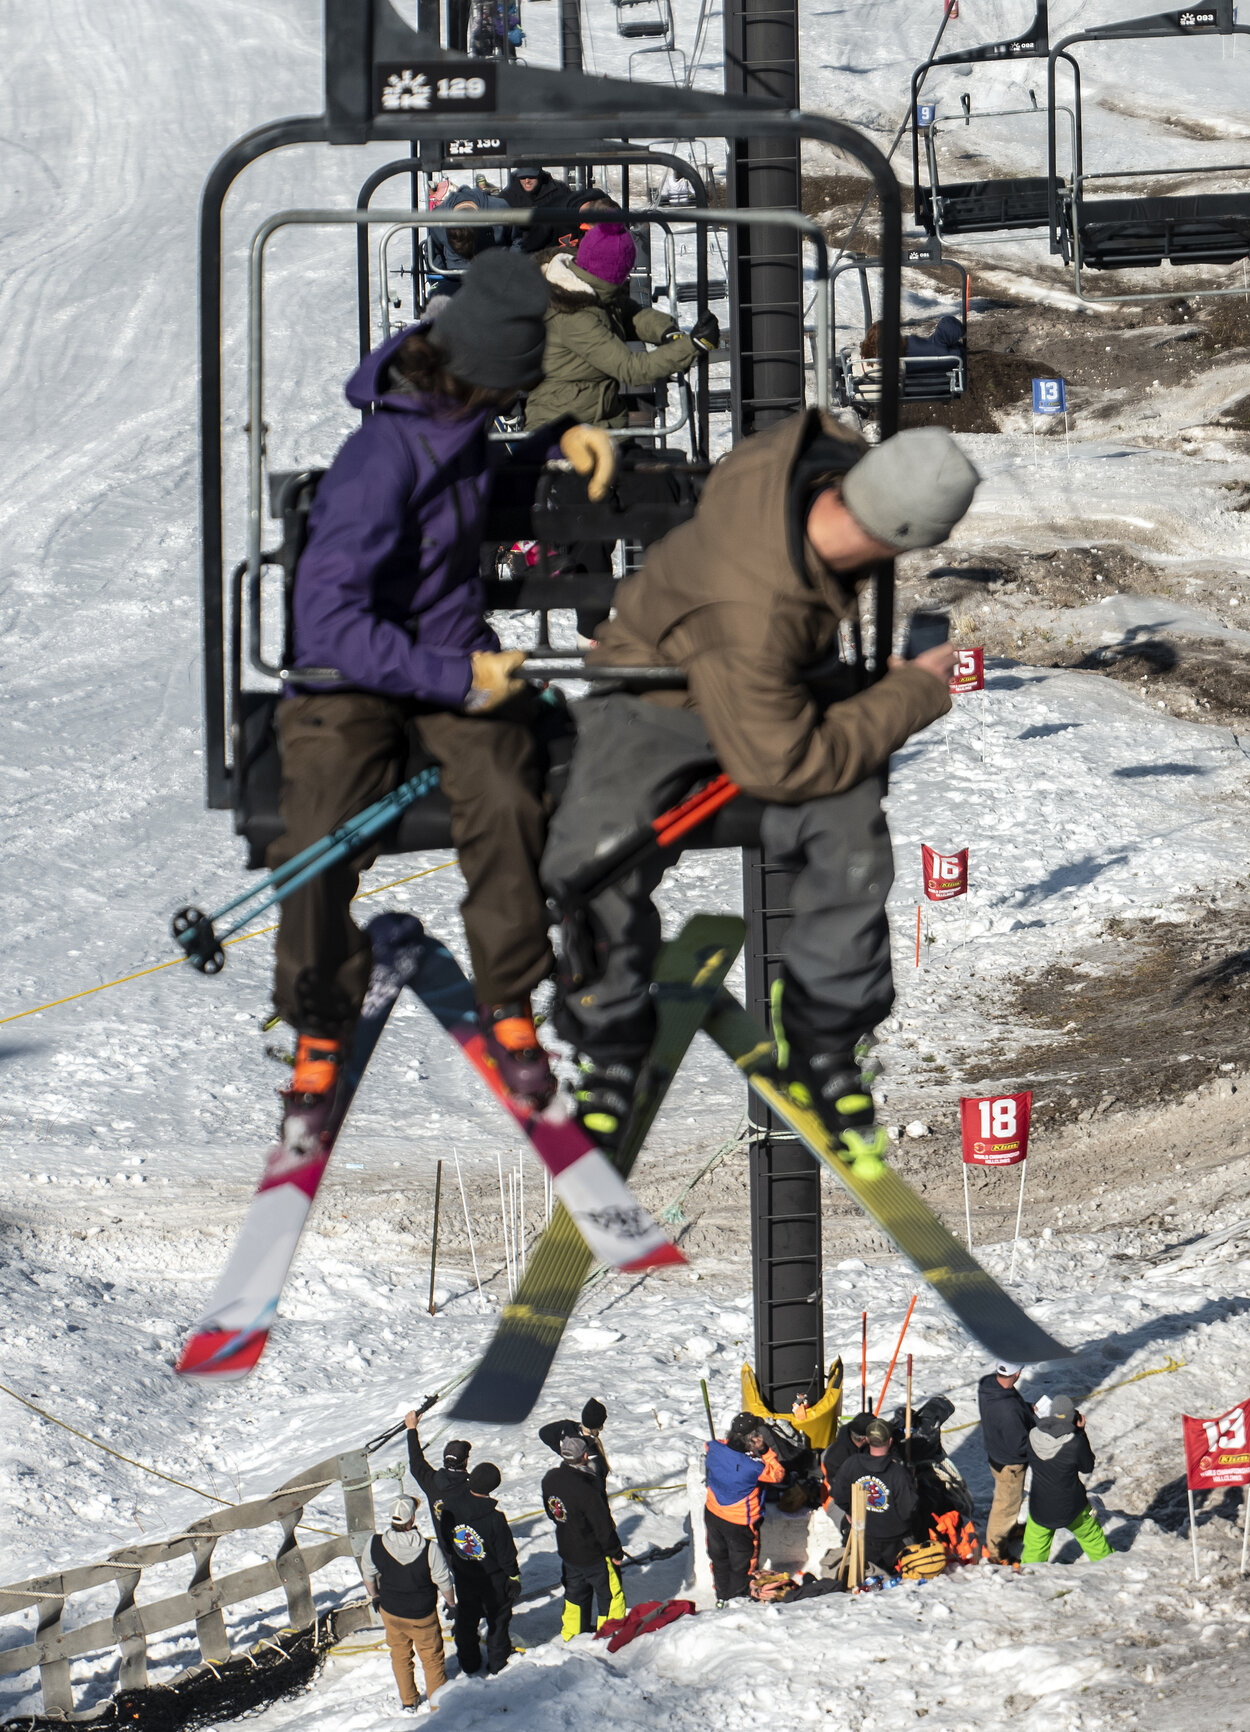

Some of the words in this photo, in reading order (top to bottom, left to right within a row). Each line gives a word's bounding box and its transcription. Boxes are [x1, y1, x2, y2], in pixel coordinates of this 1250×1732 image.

[437, 77, 486, 99] 129
[921, 106, 930, 120] 9
[1039, 381, 1058, 400] 13
[932, 853, 959, 880] 16
[978, 1098, 1017, 1139] 18
[1202, 1407, 1247, 1453] 19
